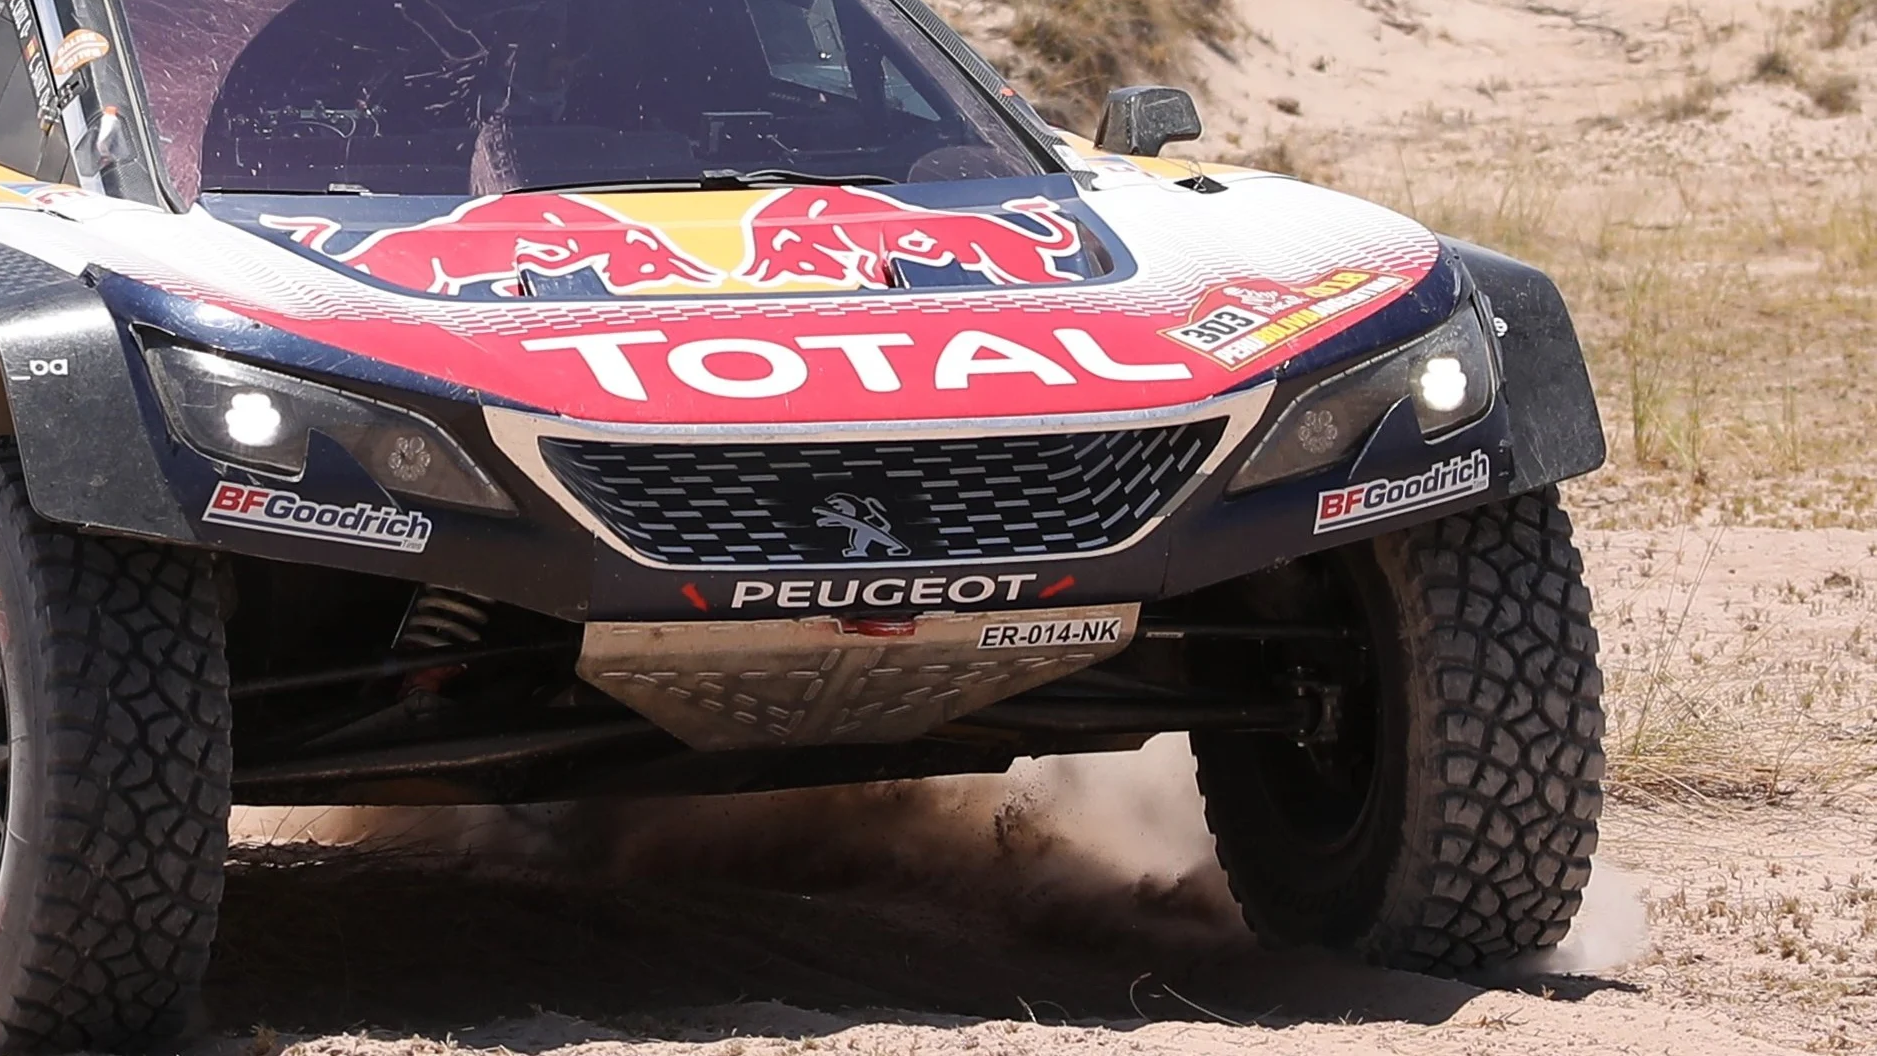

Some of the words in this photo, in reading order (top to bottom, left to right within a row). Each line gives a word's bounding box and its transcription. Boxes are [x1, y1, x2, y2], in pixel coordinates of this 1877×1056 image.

[1180, 310, 1256, 345] 303
[1212, 335, 1268, 366] PERU
[1253, 308, 1325, 346] BOLIVIA
[520, 328, 1194, 402] TOTAL
[212, 484, 432, 540] BFGoodrich
[1320, 453, 1488, 521] BFGoodrich
[730, 573, 1038, 609] PEUGEOT
[982, 619, 1120, 647] ER-014-NK
